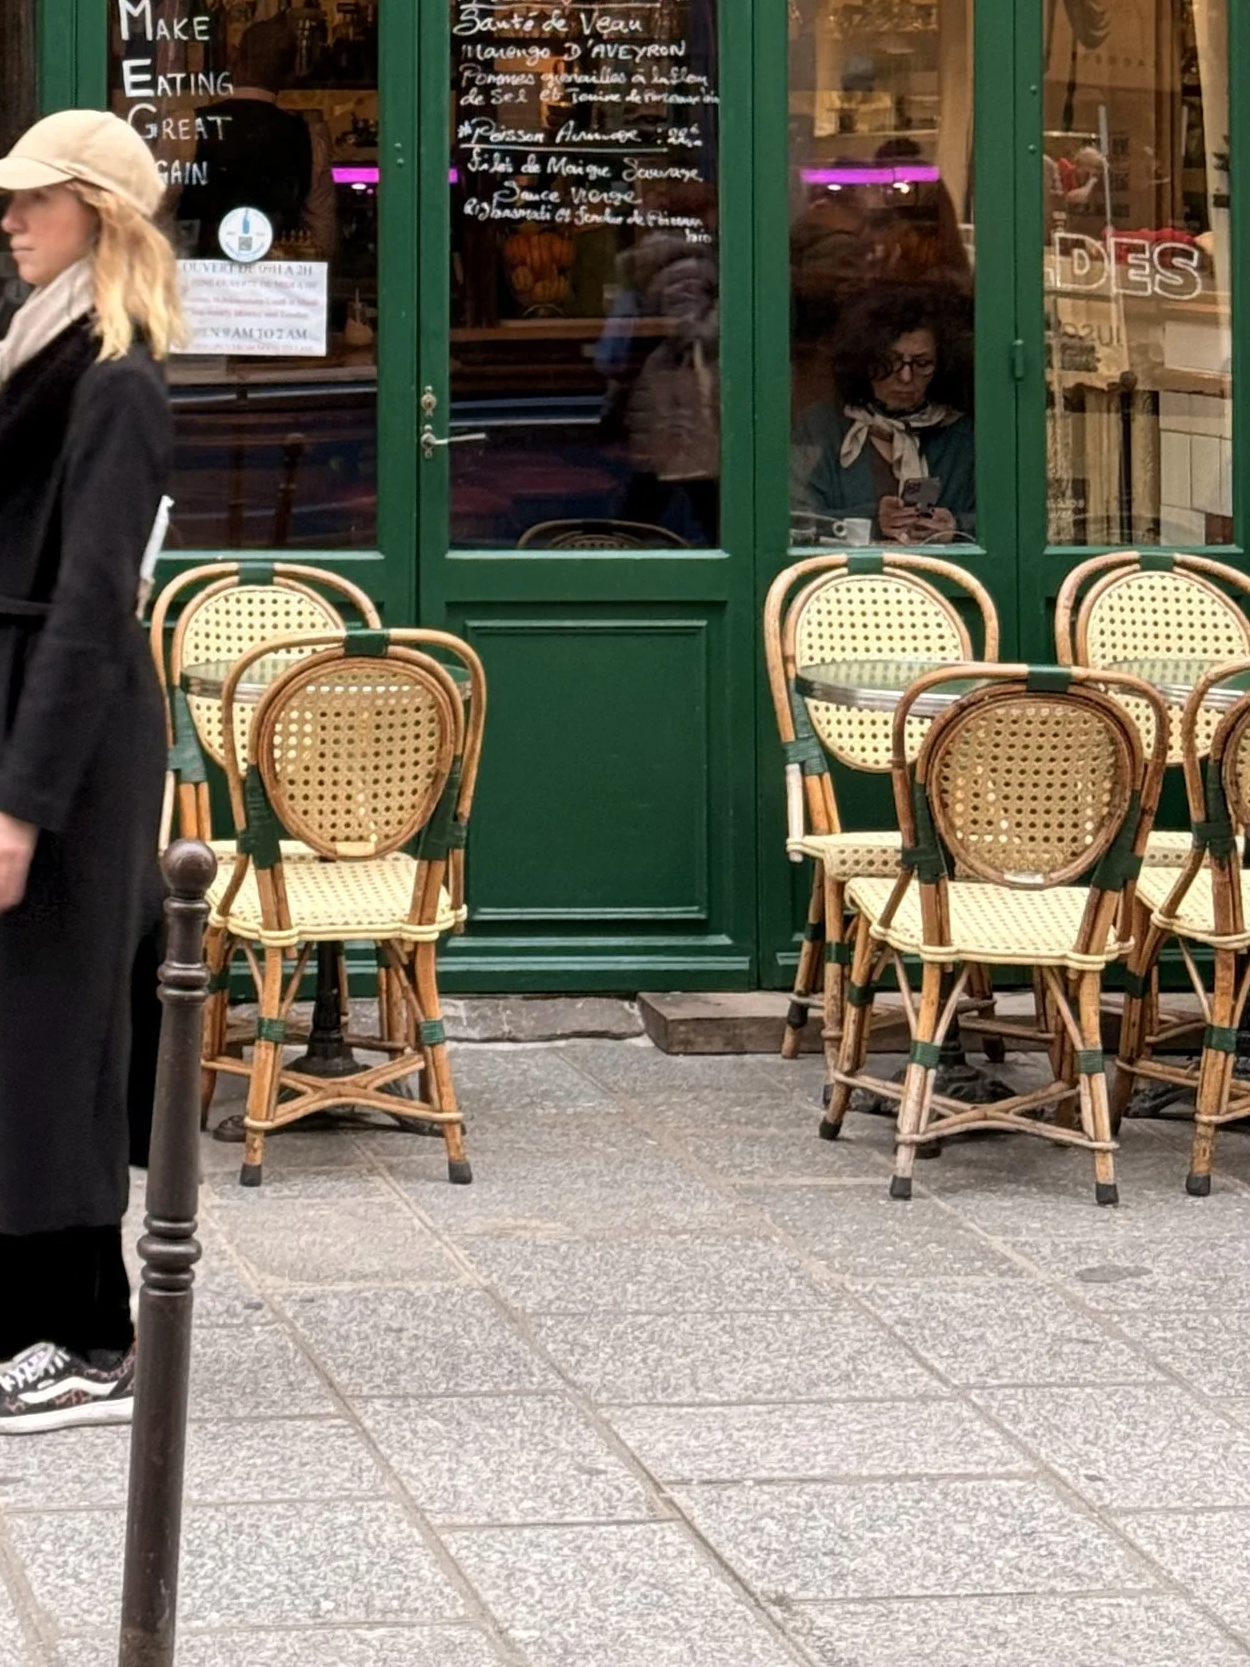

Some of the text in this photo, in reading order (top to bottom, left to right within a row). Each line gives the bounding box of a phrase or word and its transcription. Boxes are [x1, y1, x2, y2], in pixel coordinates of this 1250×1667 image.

[542, 9, 568, 32] de
[580, 9, 642, 35] Veau
[470, 117, 544, 144] Poisson
[155, 159, 209, 186] GAIN
[1043, 231, 1203, 301] DES
